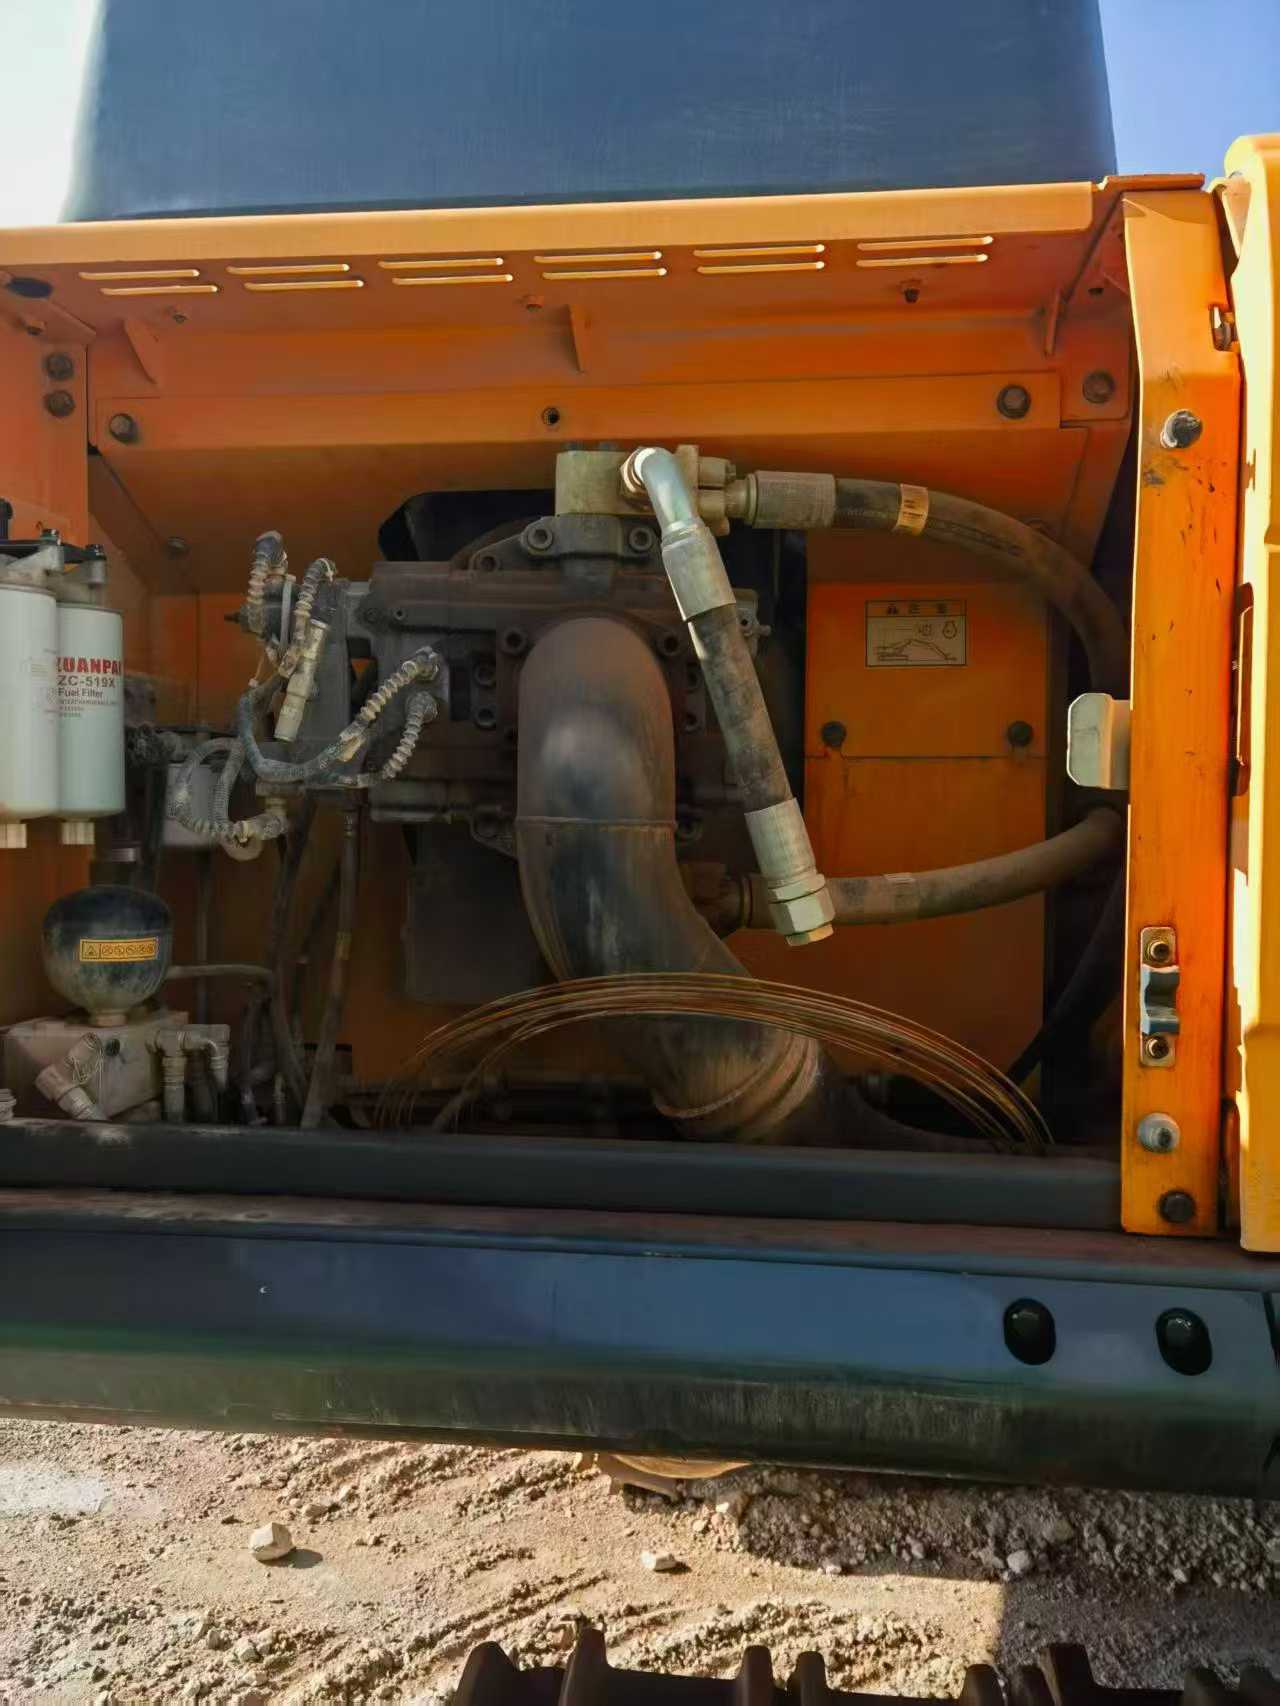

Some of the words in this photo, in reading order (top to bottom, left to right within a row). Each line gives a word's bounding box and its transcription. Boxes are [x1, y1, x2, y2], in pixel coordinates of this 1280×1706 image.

[57, 674, 116, 688] ZC-519X
[58, 687, 80, 697] Fuel
[81, 687, 104, 698] Filter
